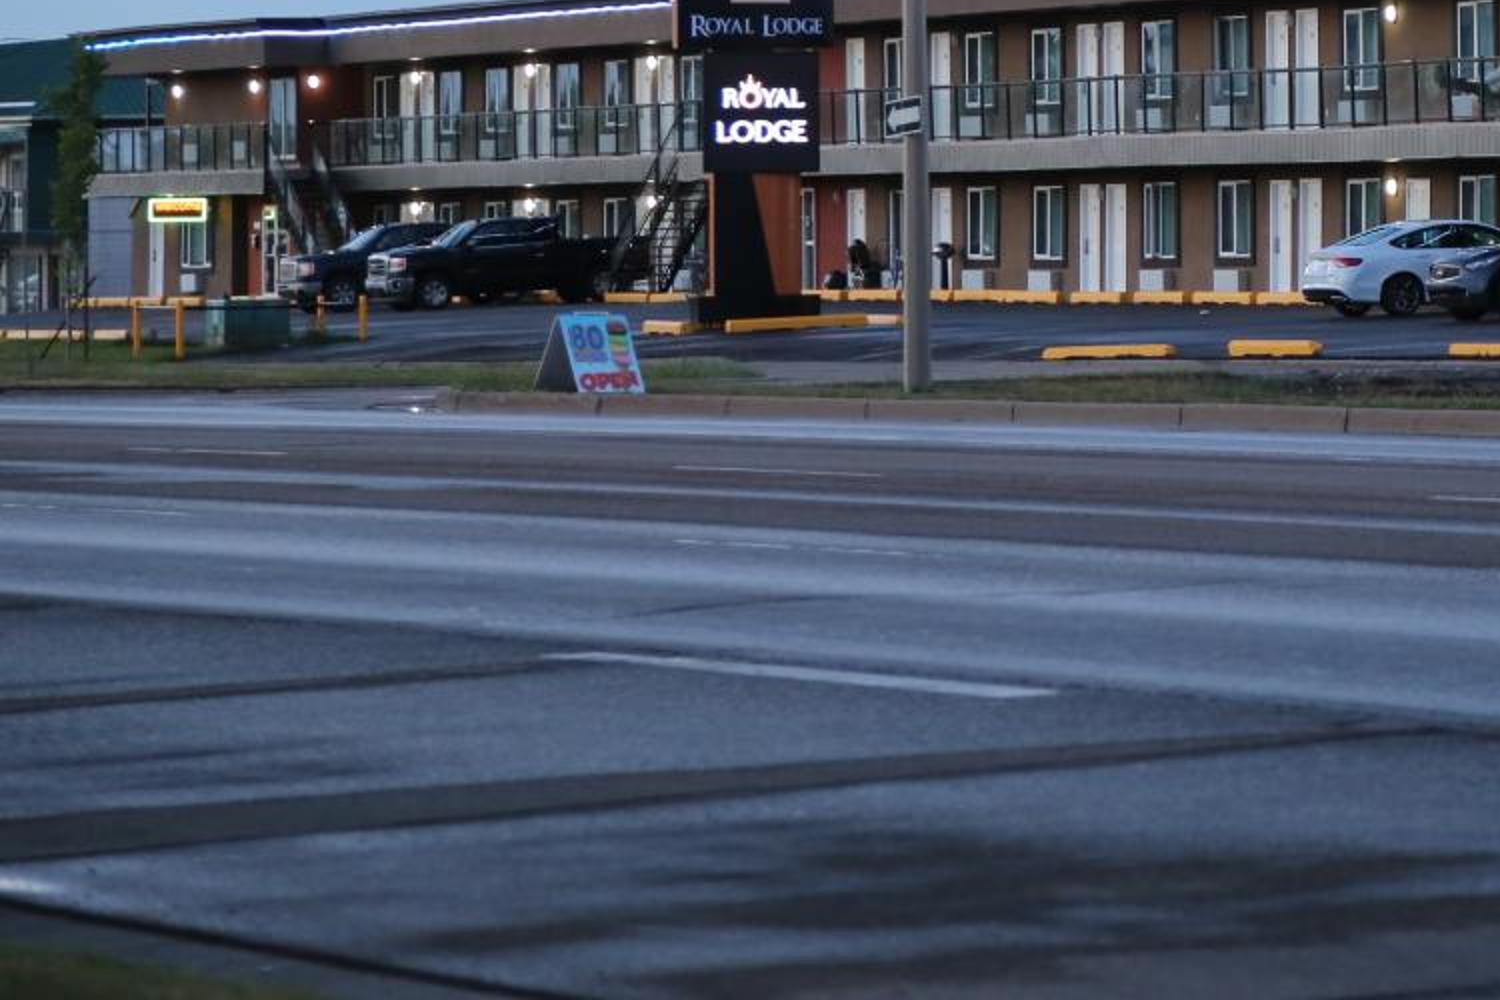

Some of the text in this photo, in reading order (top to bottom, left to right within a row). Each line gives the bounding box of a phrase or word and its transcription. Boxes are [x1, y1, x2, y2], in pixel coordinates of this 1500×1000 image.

[690, 15, 824, 37] ROYAL LODGE
[721, 84, 807, 109] ROYAL
[714, 119, 809, 143] LODGE
[580, 371, 640, 390] OPEN
